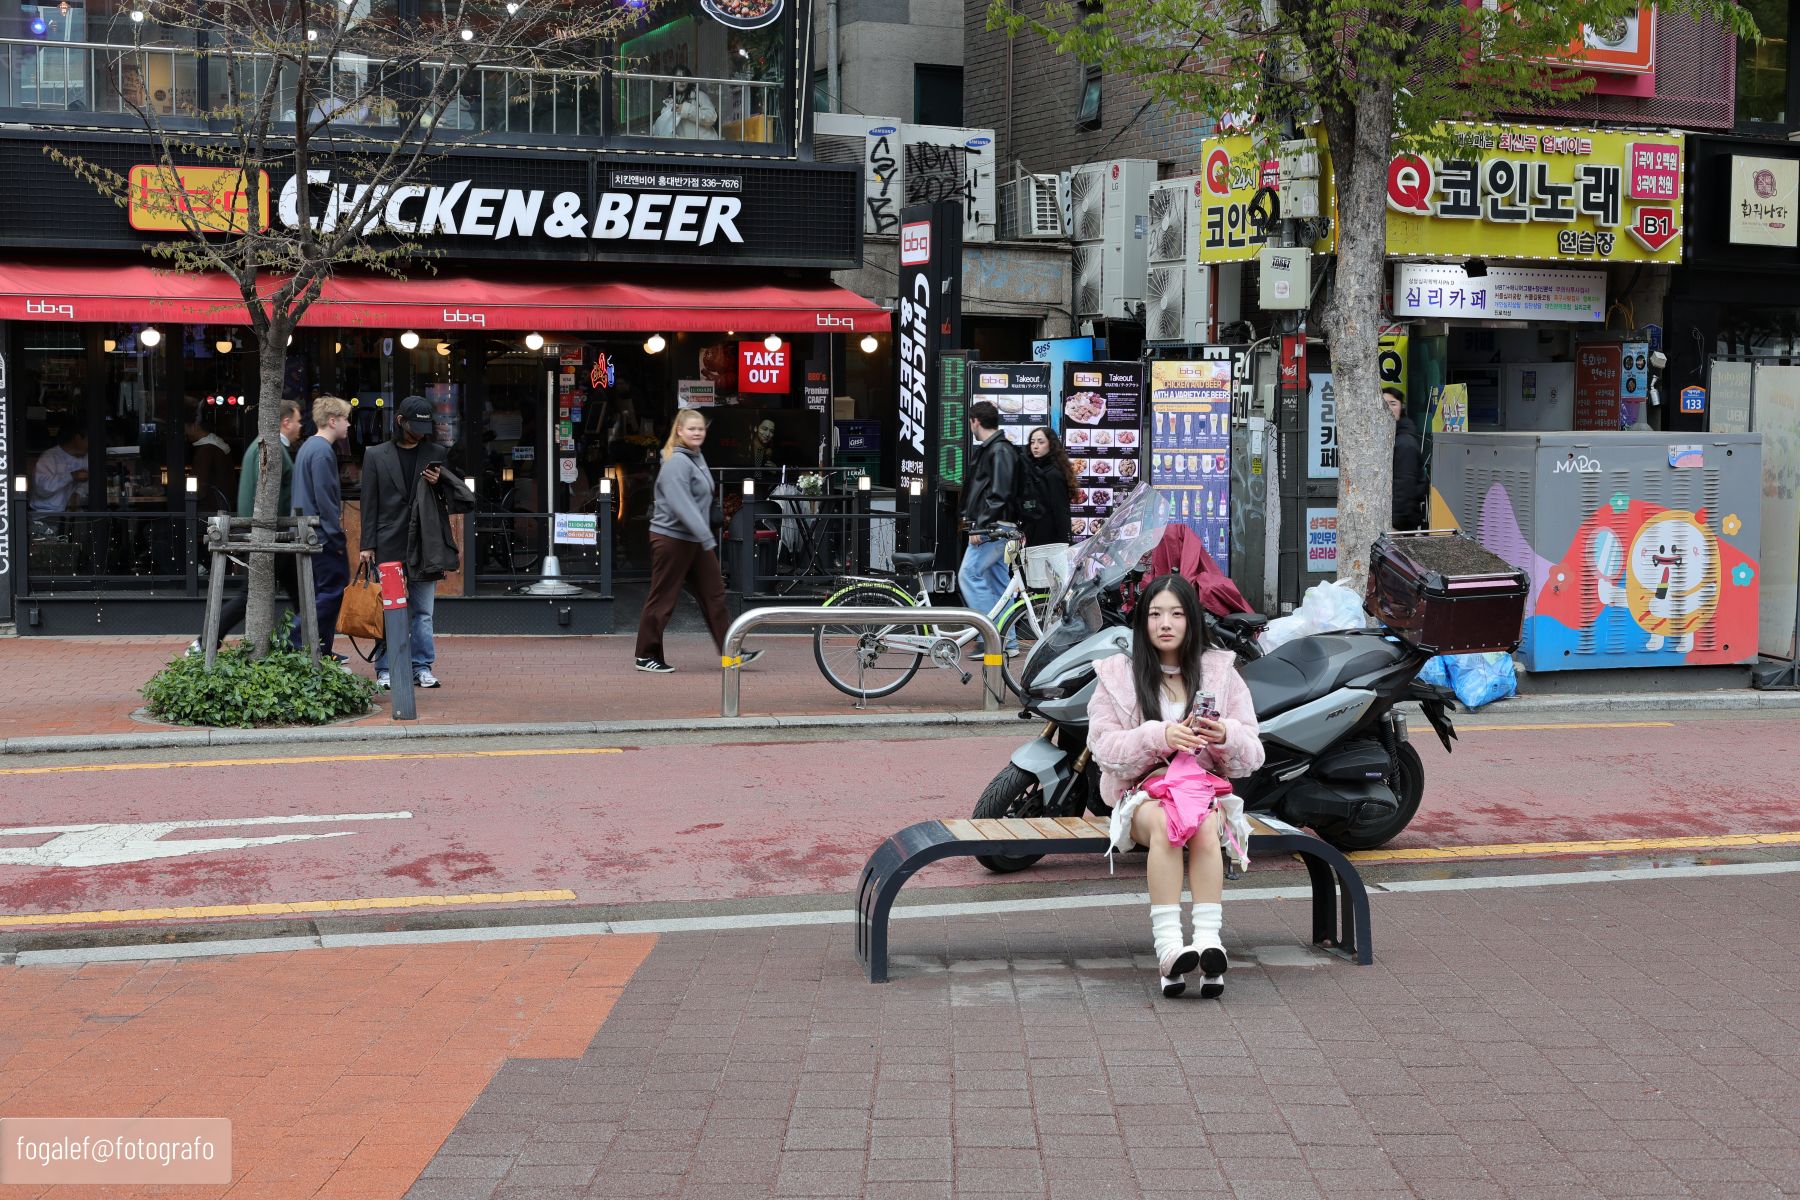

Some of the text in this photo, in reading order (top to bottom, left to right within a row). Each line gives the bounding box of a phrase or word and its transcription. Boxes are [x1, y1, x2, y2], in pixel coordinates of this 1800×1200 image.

[1499, 134, 1538, 151] 최신곡
[1207, 150, 1230, 194] Q
[614, 174, 740, 189] 치킨앤비어 홍대반가점 336-7676
[1111, 182, 1119, 191] LG
[1386, 153, 1622, 227] Q 코인노래
[278, 169, 745, 247] CHICKEN & BEER
[1644, 216, 1670, 235] B1
[1560, 230, 1616, 256] 연습장
[1405, 286, 1487, 310] 심리카페
[743, 351, 785, 366] TAKE
[912, 272, 930, 456] CHICKEN
[1378, 350, 1402, 383] Q
[748, 369, 780, 383] OUT
[899, 296, 913, 442] & BEER
[1108, 373, 1134, 382] Takeout
[1015, 374, 1041, 383] Takeout
[1164, 380, 1190, 389] CHICKEN
[1206, 380, 1222, 389] BEER
[807, 396, 827, 404] CRAFT
[1153, 390, 1169, 399] WITH
[1175, 390, 1201, 399] VARIETY
[1210, 390, 1230, 399] BEERS
[1685, 399, 1702, 411] 133
[939, 356, 965, 485] BBQ
